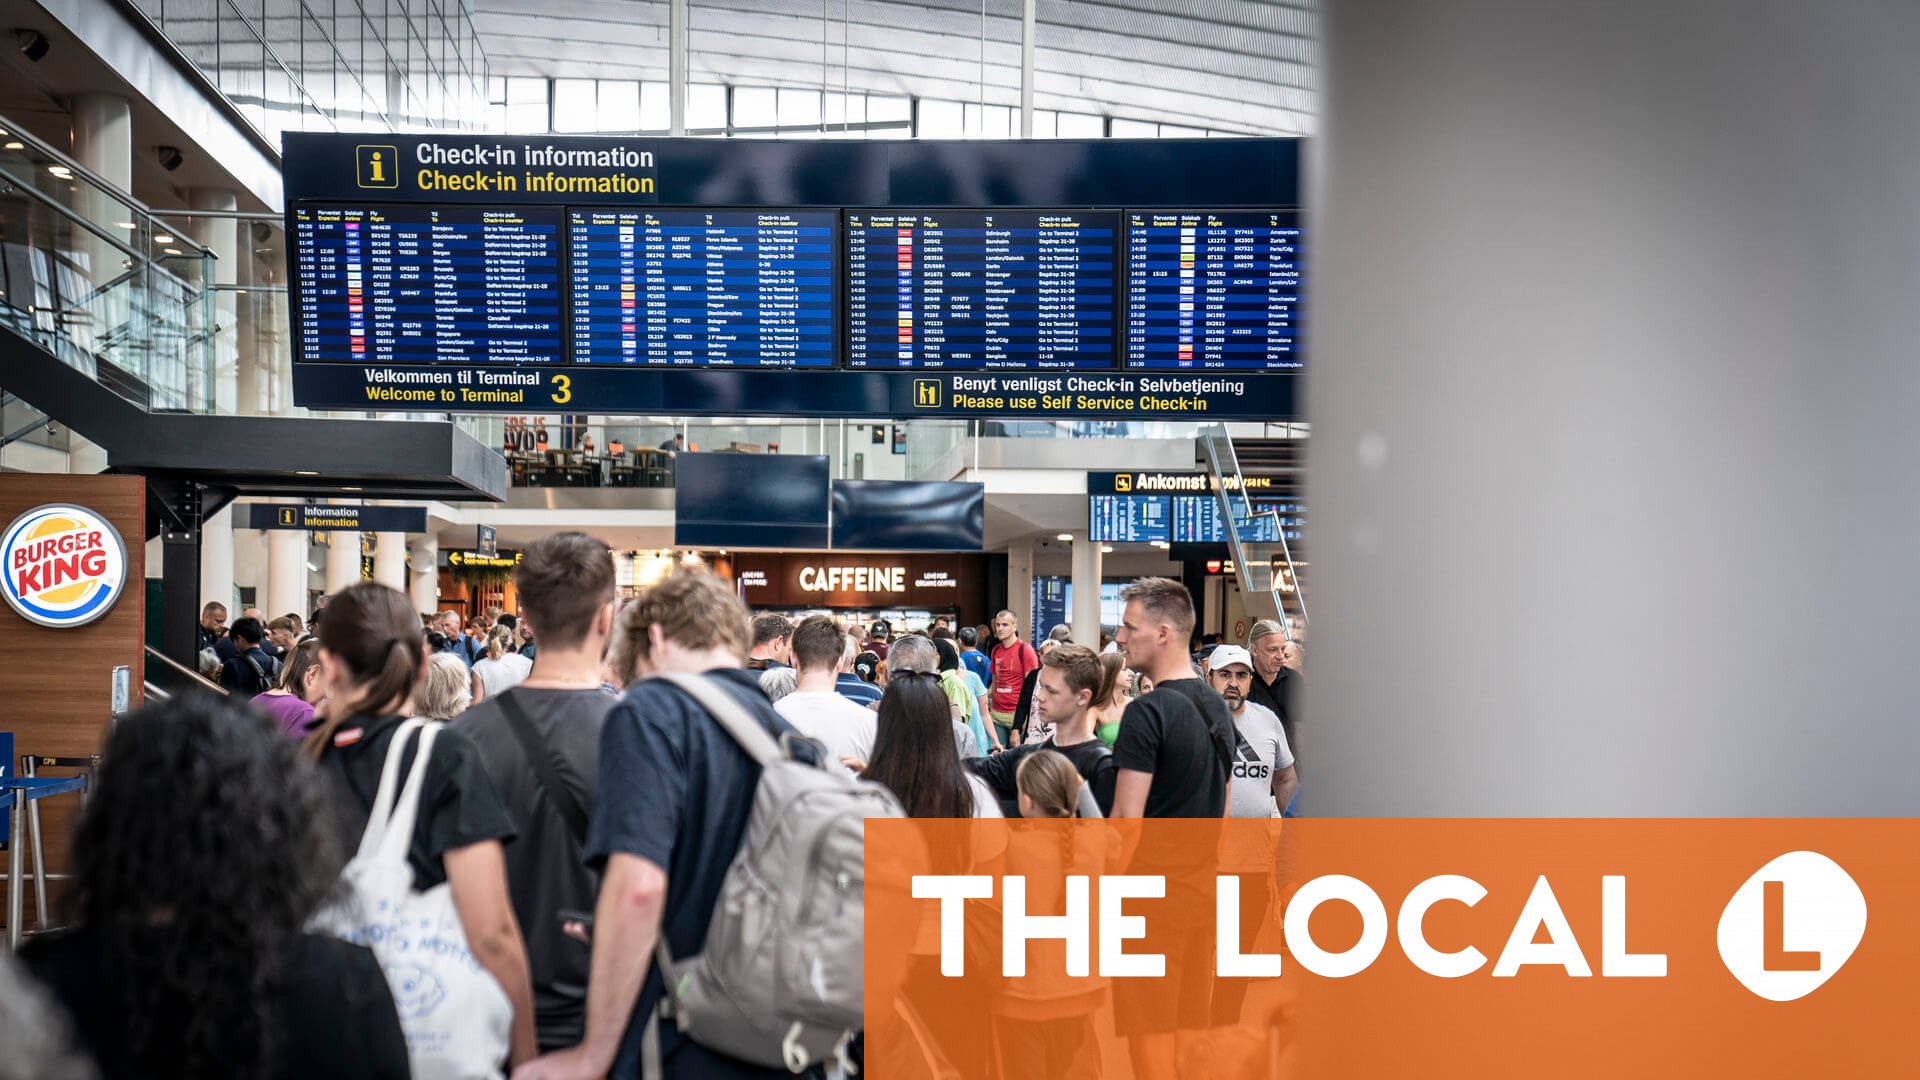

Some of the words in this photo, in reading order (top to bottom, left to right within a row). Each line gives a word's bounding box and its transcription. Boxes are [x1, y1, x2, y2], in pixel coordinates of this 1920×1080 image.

[417, 143, 517, 166] Check-in
[525, 145, 654, 168] information
[417, 169, 517, 191] Check-in
[525, 171, 654, 194] information
[364, 369, 452, 384] Velkommen
[457, 370, 472, 384] til
[476, 370, 540, 386] Terminal
[953, 376, 997, 394] Benyt
[1001, 376, 1062, 394] venligst
[1066, 377, 1134, 393] Check-in
[1139, 377, 1244, 396] Selvbetjening
[365, 386, 436, 401] Welcome
[440, 388, 456, 402] to
[460, 387, 523, 403] Terminal
[551, 374, 572, 404] 3
[953, 394, 1004, 409] Please
[1009, 397, 1037, 410] use
[1042, 395, 1072, 410] Self
[1077, 395, 1135, 410] Service
[1139, 395, 1207, 410] Check-in
[1136, 473, 1206, 490] Ankomst
[304, 506, 358, 517] Information
[304, 517, 358, 528] Information
[14, 531, 103, 570] BURGER
[18, 549, 107, 598] KING
[799, 566, 906, 592] CAFFEINE
[43, 757, 56, 766] CPH
[1233, 761, 1269, 779] das
